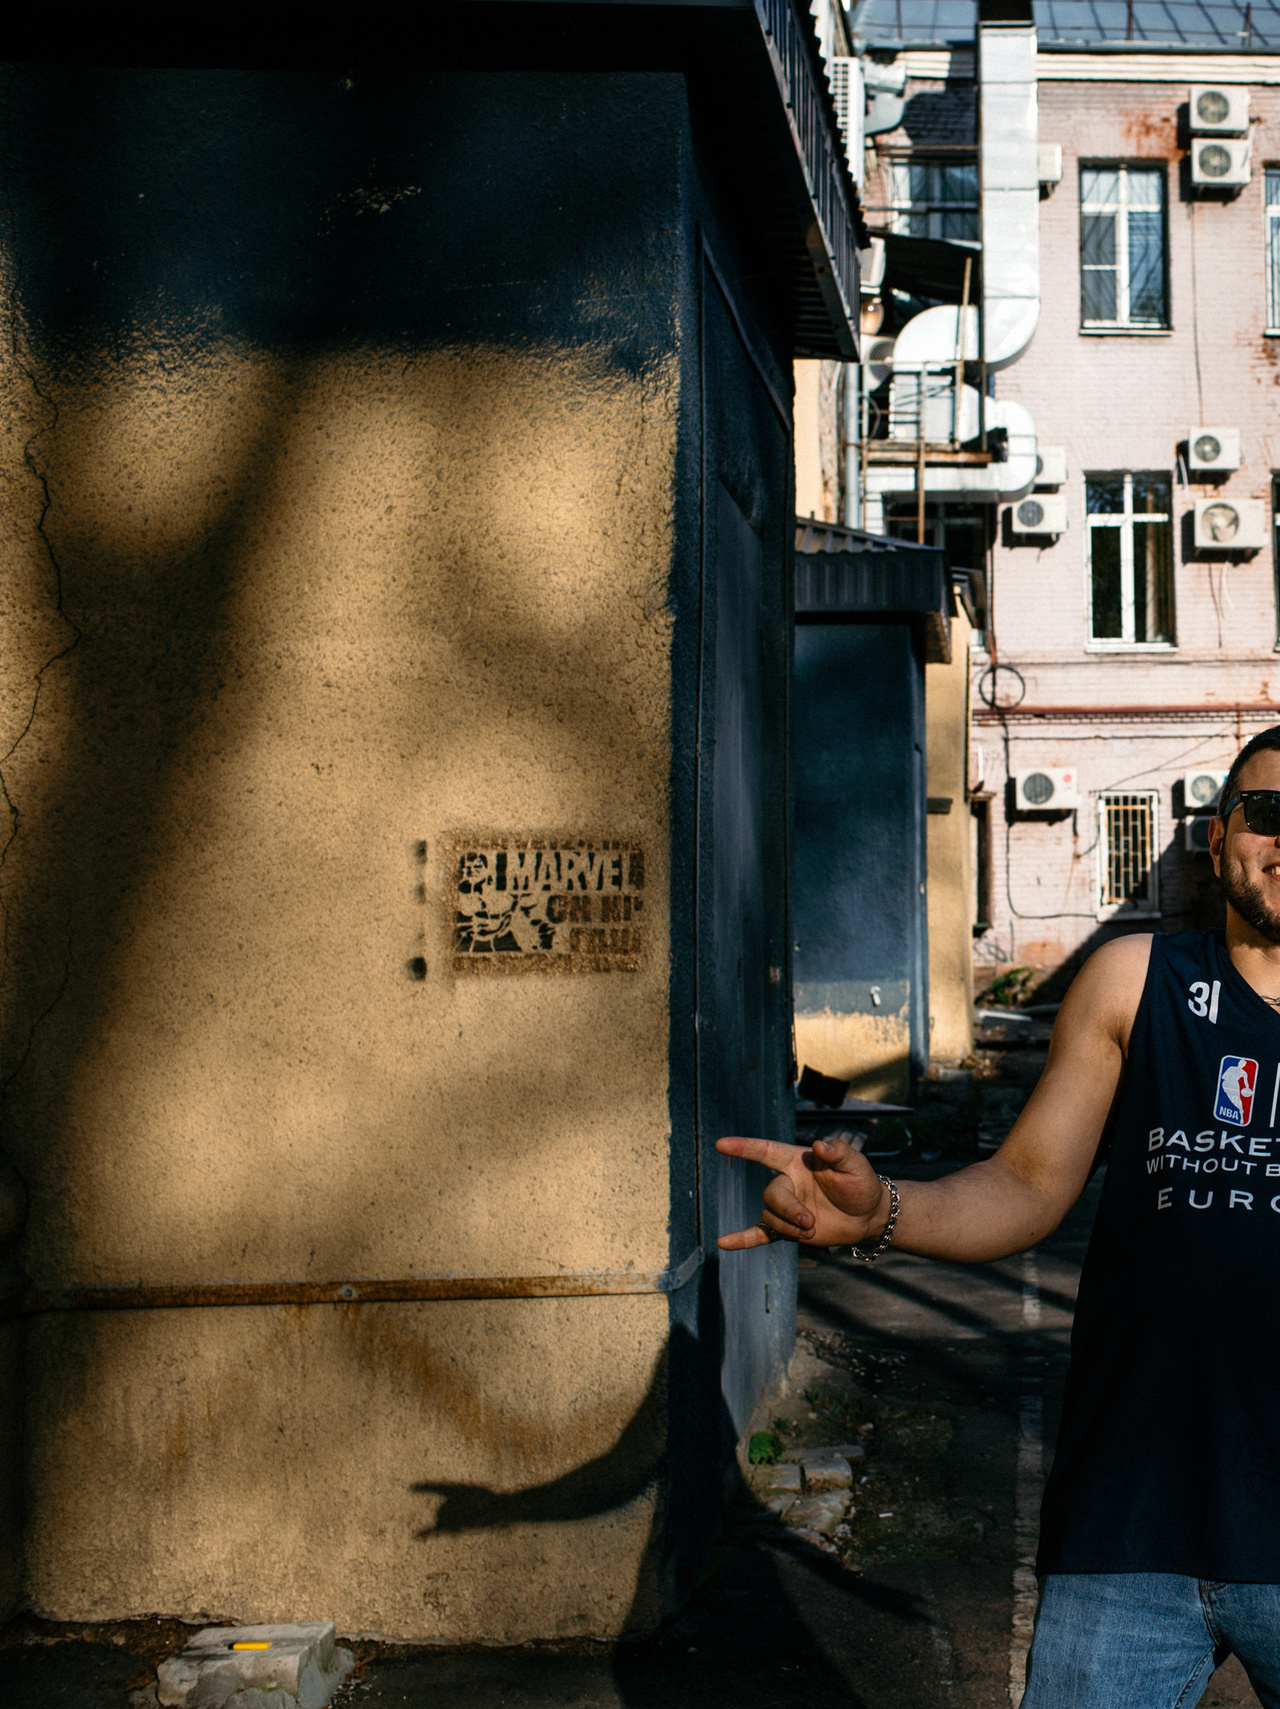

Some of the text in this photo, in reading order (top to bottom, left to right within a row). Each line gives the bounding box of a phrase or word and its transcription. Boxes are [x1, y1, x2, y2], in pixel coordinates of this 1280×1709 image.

[506, 851, 638, 891] MARVEL
[1188, 980, 1221, 1024] 31
[1219, 1106, 1239, 1121] NBA
[1147, 1154, 1257, 1175] WITHOUT
